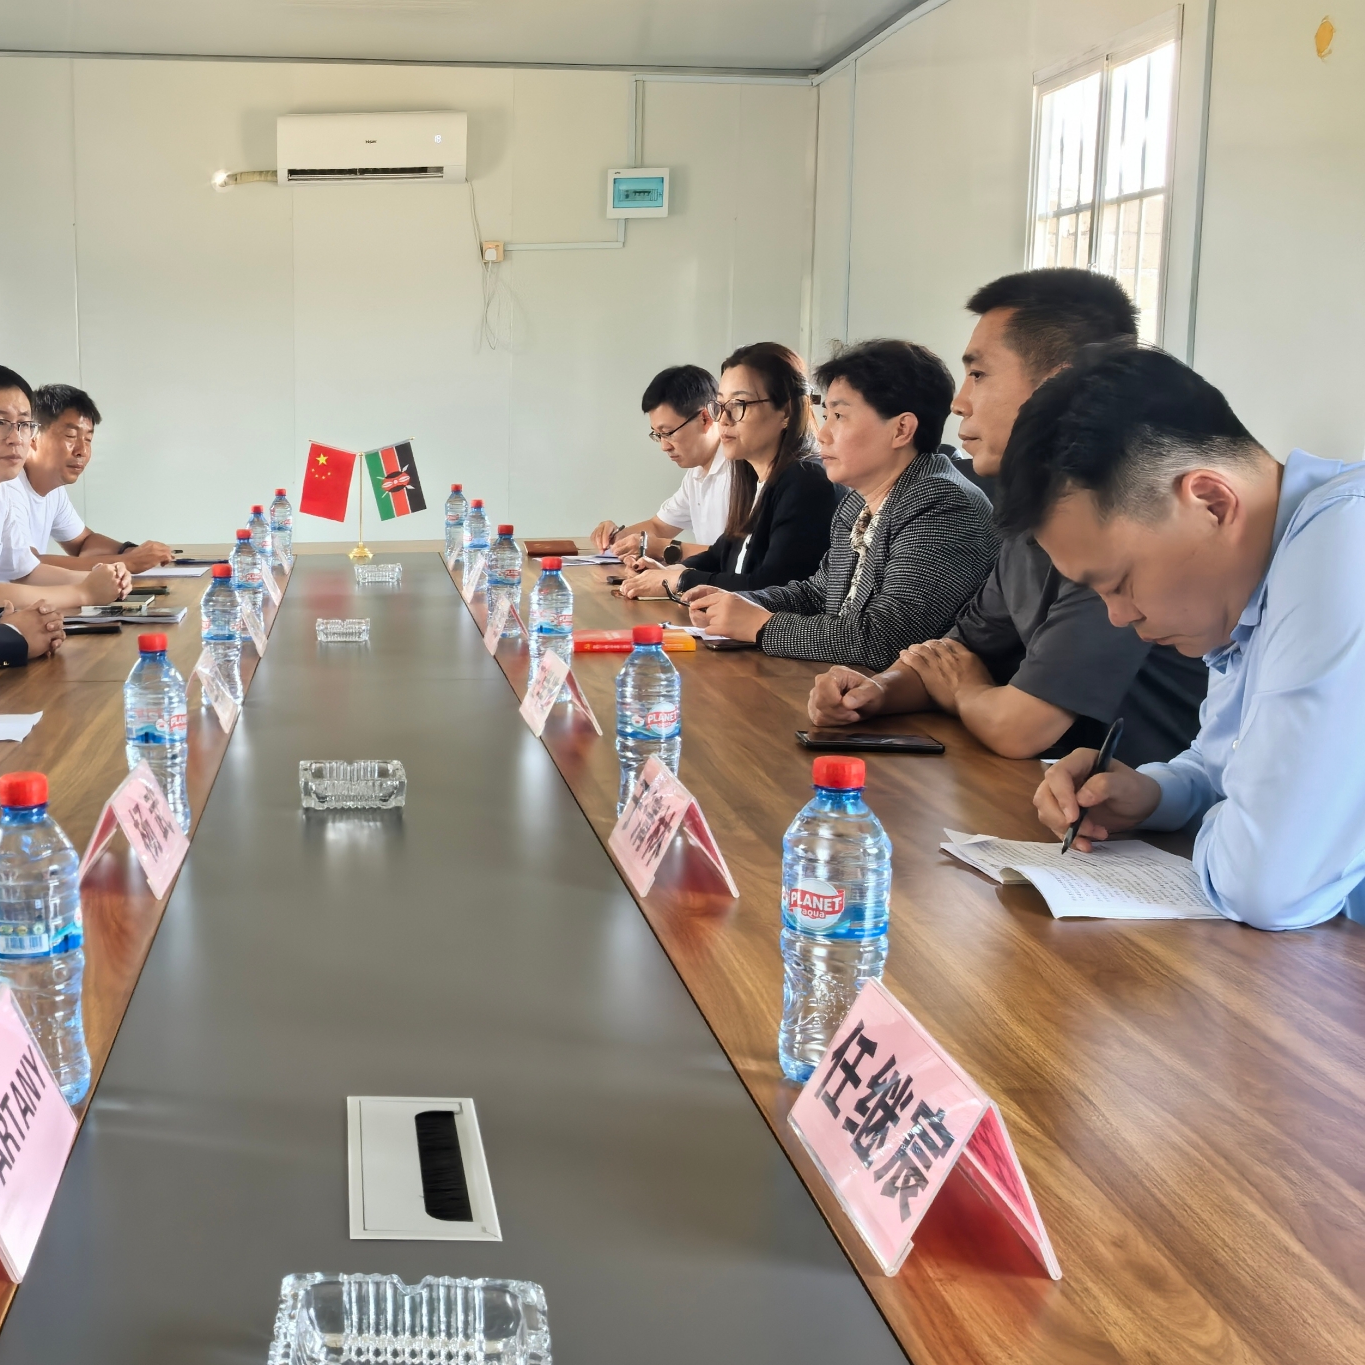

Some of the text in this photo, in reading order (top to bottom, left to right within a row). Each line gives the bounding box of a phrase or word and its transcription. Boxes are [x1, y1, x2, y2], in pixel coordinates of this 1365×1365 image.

[791, 891, 842, 912] PLANET
[802, 908, 825, 918] aqua
[814, 1018, 956, 1224] 任继宸
